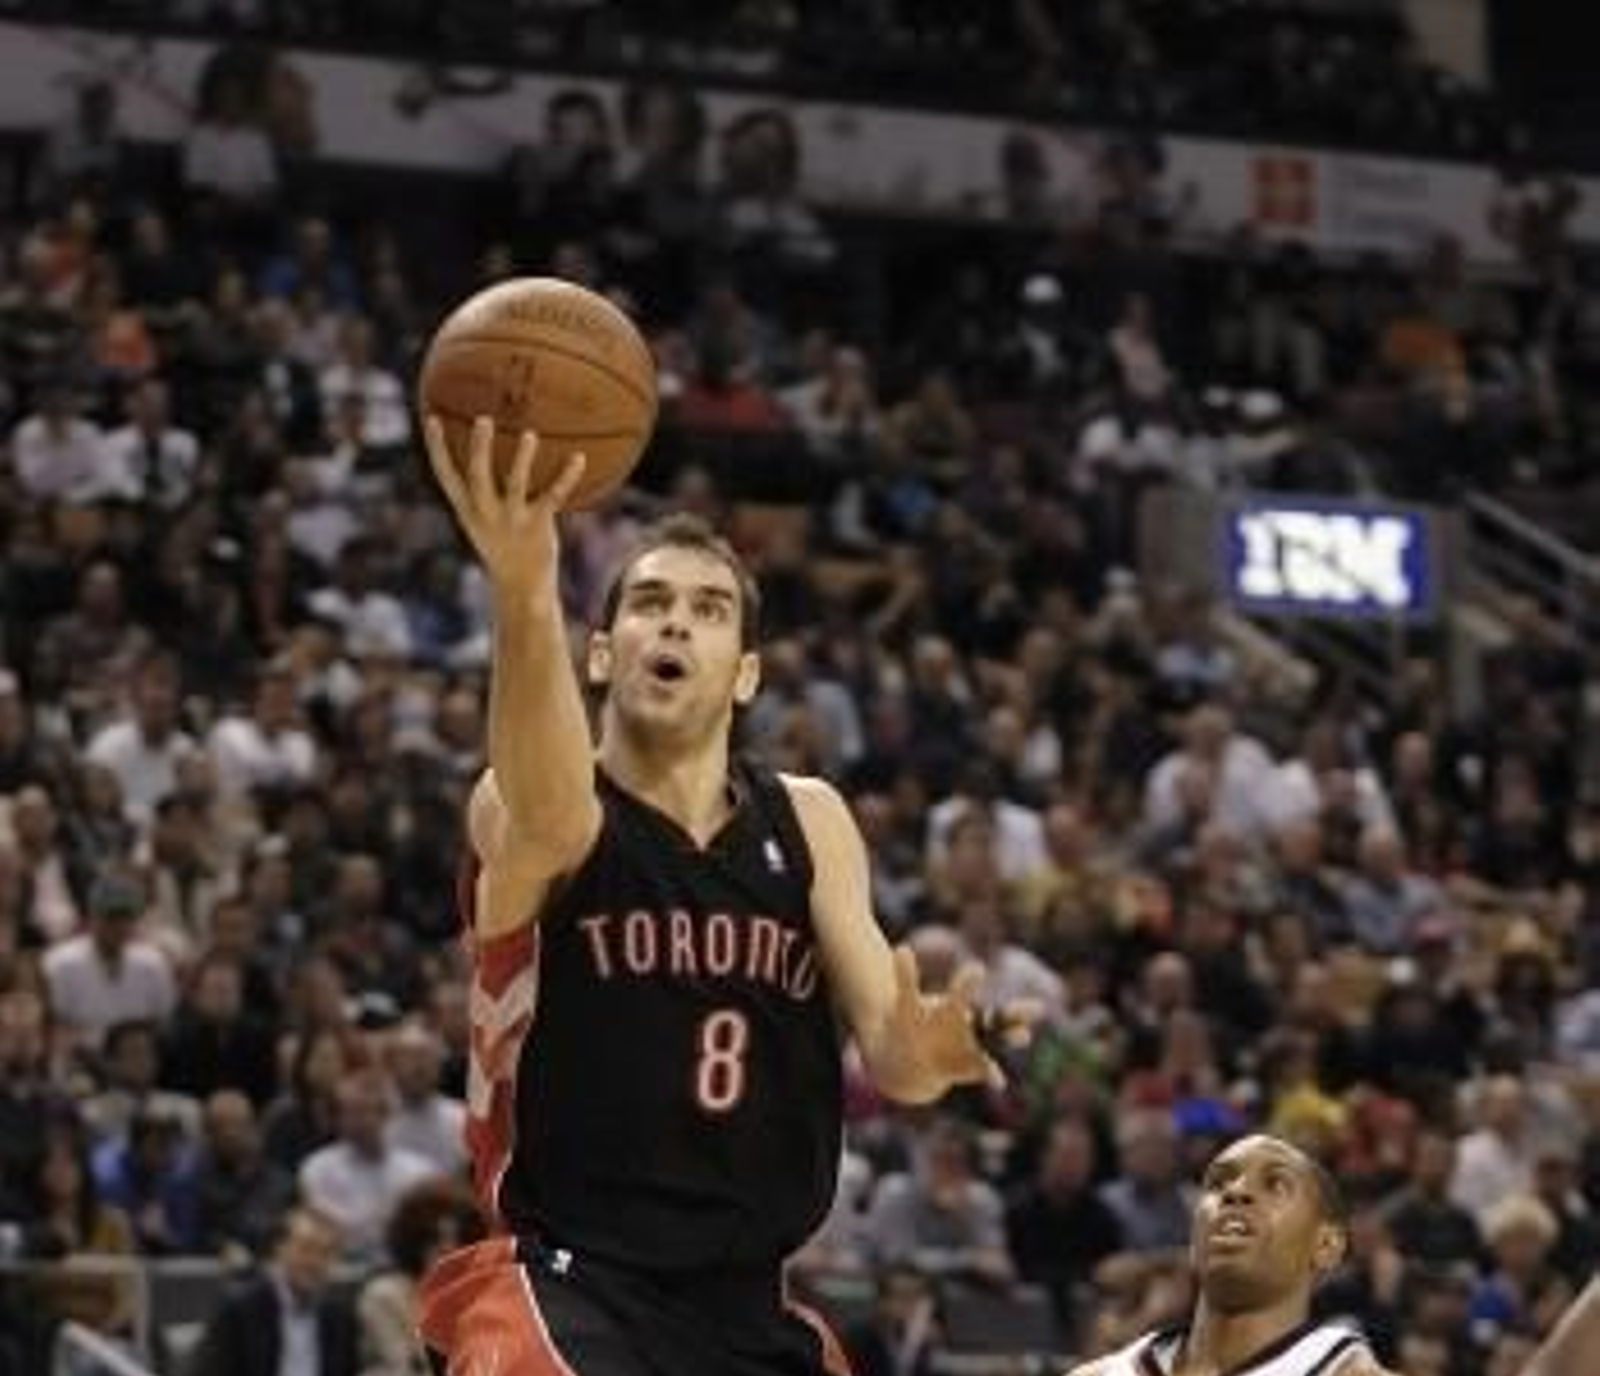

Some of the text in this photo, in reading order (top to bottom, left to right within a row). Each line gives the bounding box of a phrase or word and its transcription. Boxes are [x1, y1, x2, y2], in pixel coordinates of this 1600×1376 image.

[1238, 511, 1411, 605] IBM
[578, 909, 817, 1000] TORONTO
[697, 1009, 748, 1109] 8
